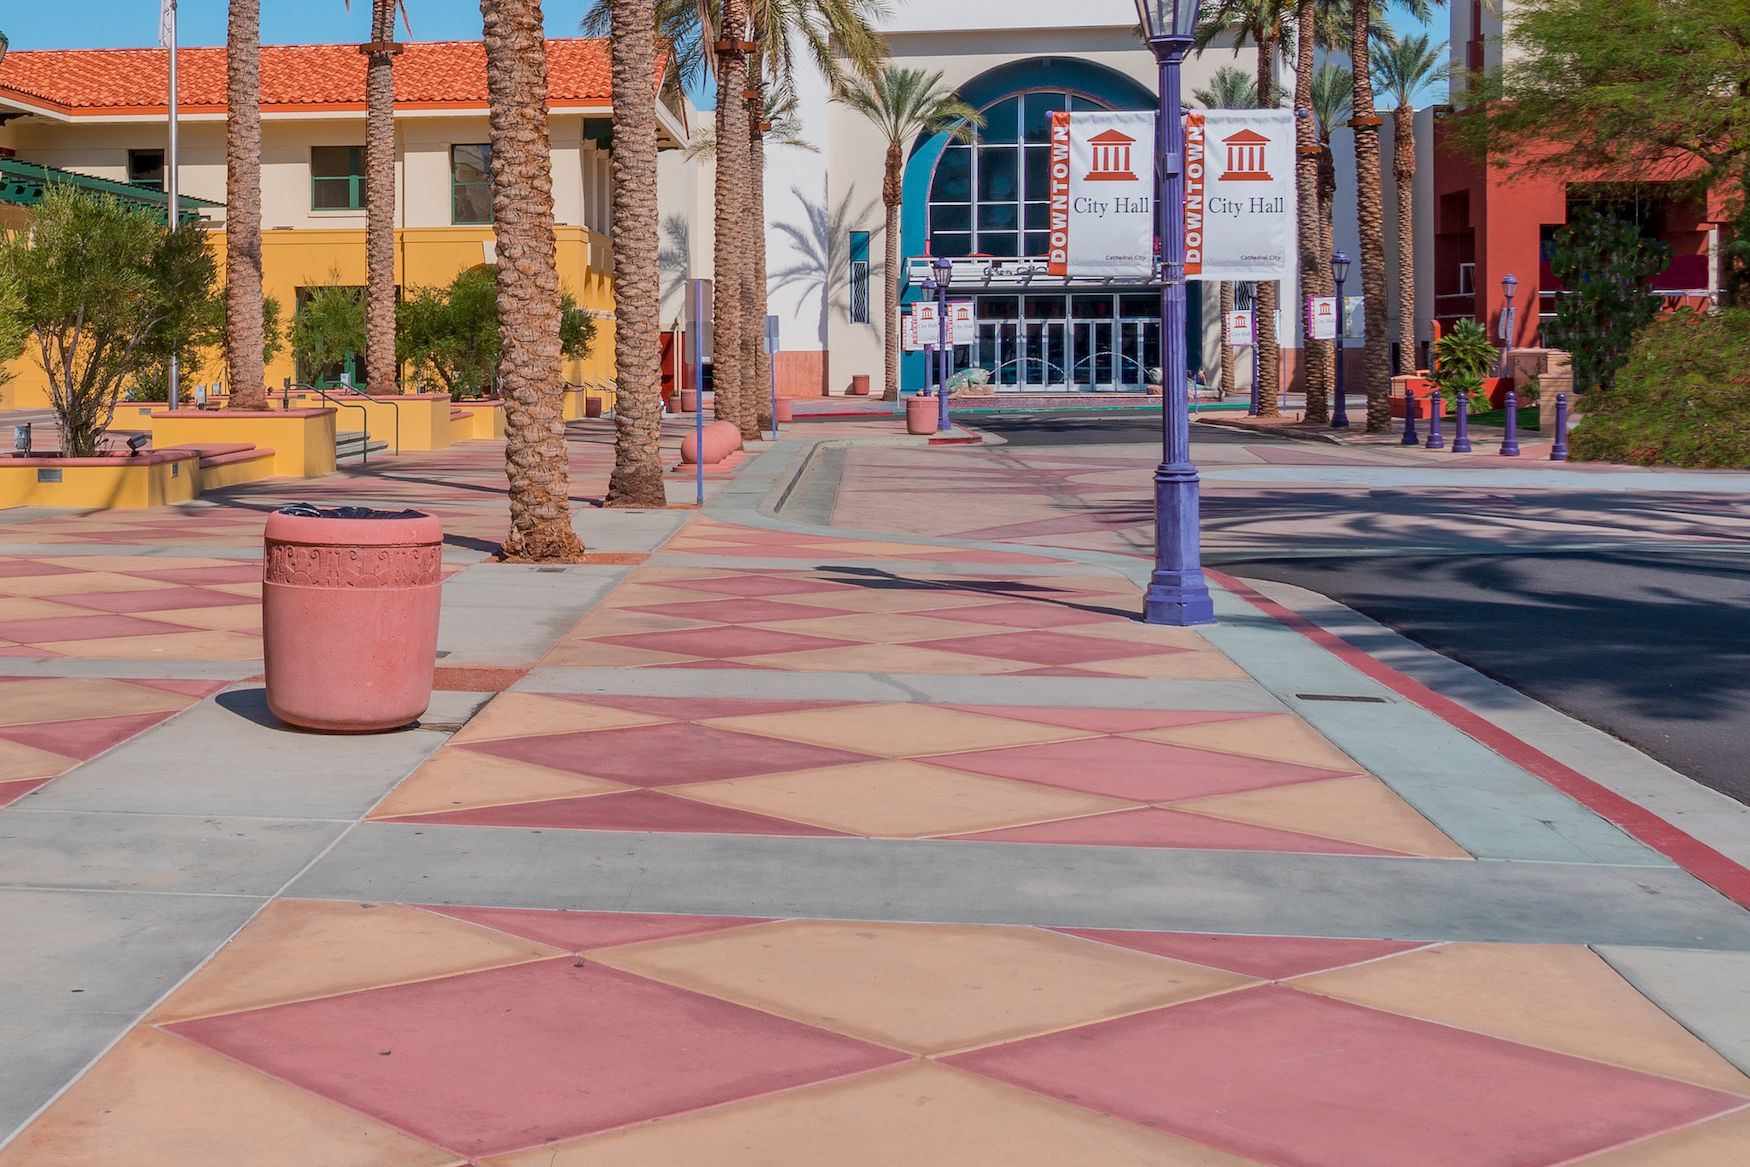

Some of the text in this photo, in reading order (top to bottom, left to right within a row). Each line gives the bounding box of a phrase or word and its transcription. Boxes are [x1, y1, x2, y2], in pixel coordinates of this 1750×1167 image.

[1051, 126, 1069, 263] DOWNTOWN
[1186, 126, 1204, 263] DOWNTOWN
[1074, 197, 1150, 218] City Hall
[1208, 197, 1284, 218] City Hall
[1134, 254, 1146, 262] City
[1269, 254, 1281, 262] City
